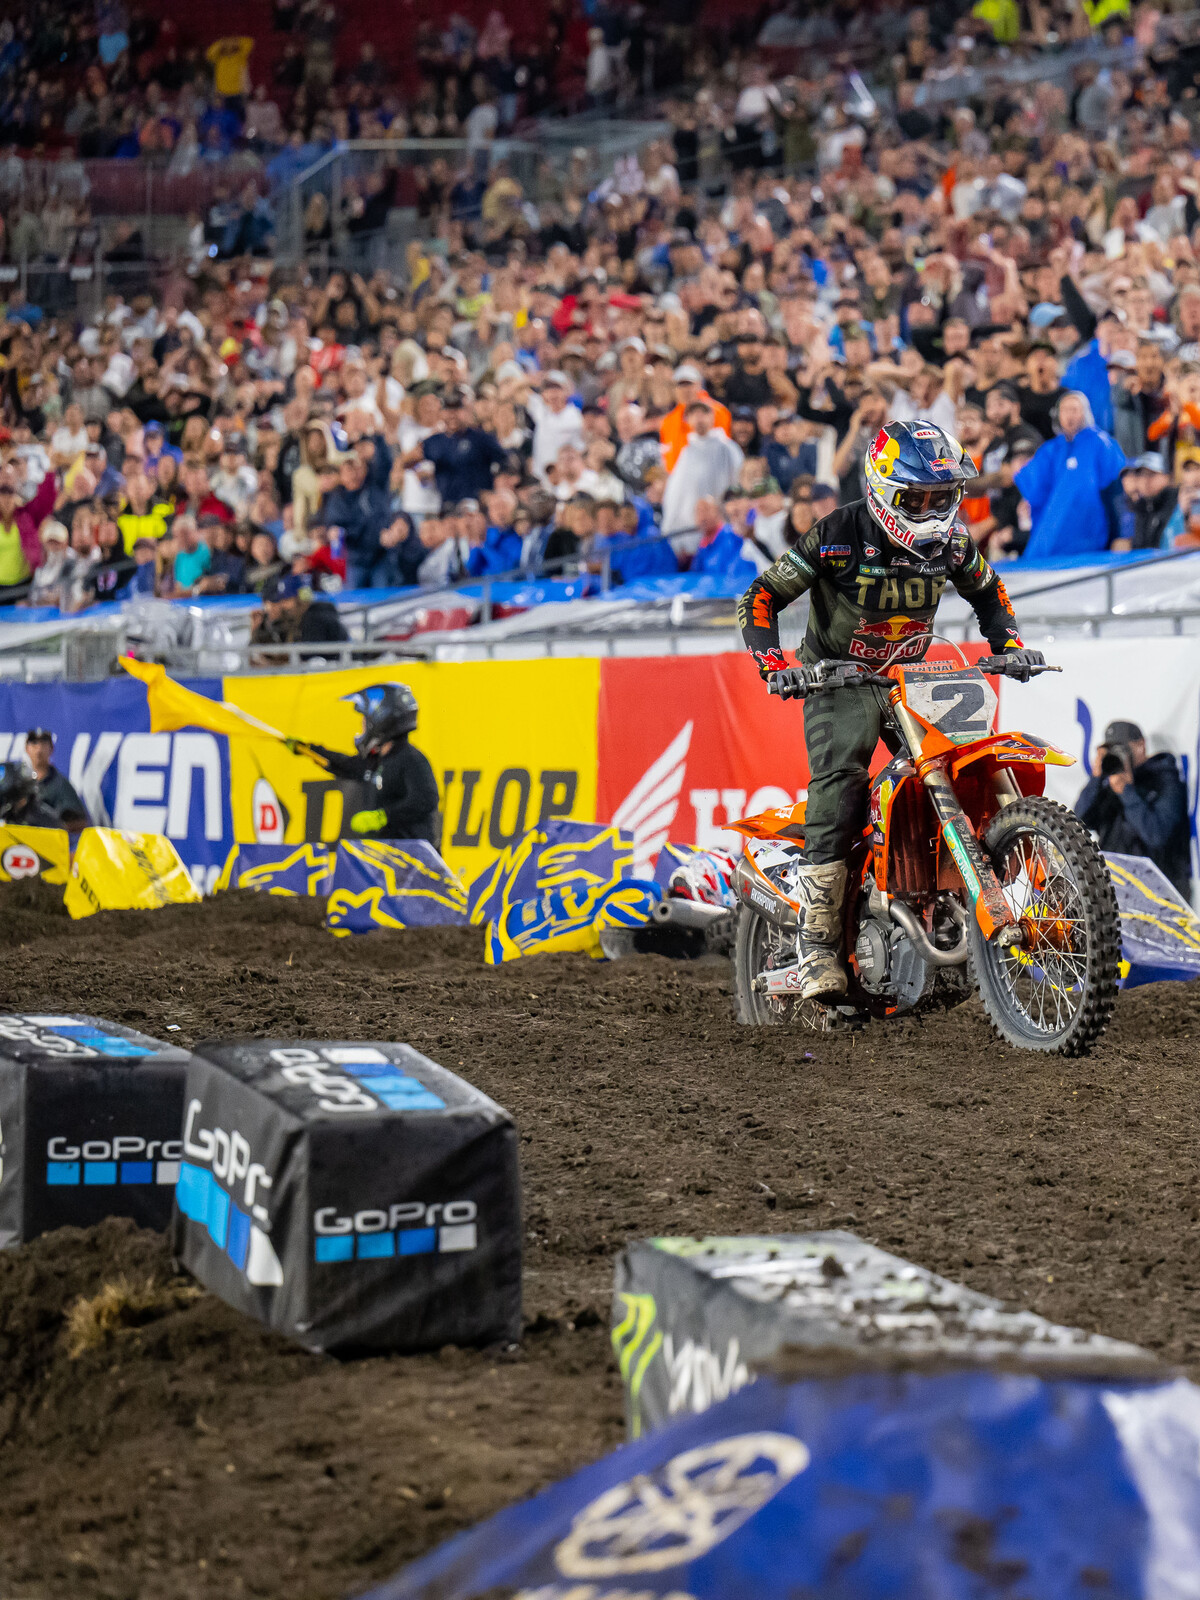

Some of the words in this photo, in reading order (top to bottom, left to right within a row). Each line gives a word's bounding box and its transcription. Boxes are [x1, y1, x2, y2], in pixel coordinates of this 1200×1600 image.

[883, 515, 916, 548] Bull
[855, 574, 947, 610] THOR
[849, 638, 890, 661] Red
[890, 638, 927, 659] Bull
[932, 682, 988, 734] 2
[301, 767, 579, 850] DLOP
[953, 849, 980, 895] MOTOREX
[46, 1135, 184, 1161] GoPro
[313, 1200, 478, 1235] GoPro
